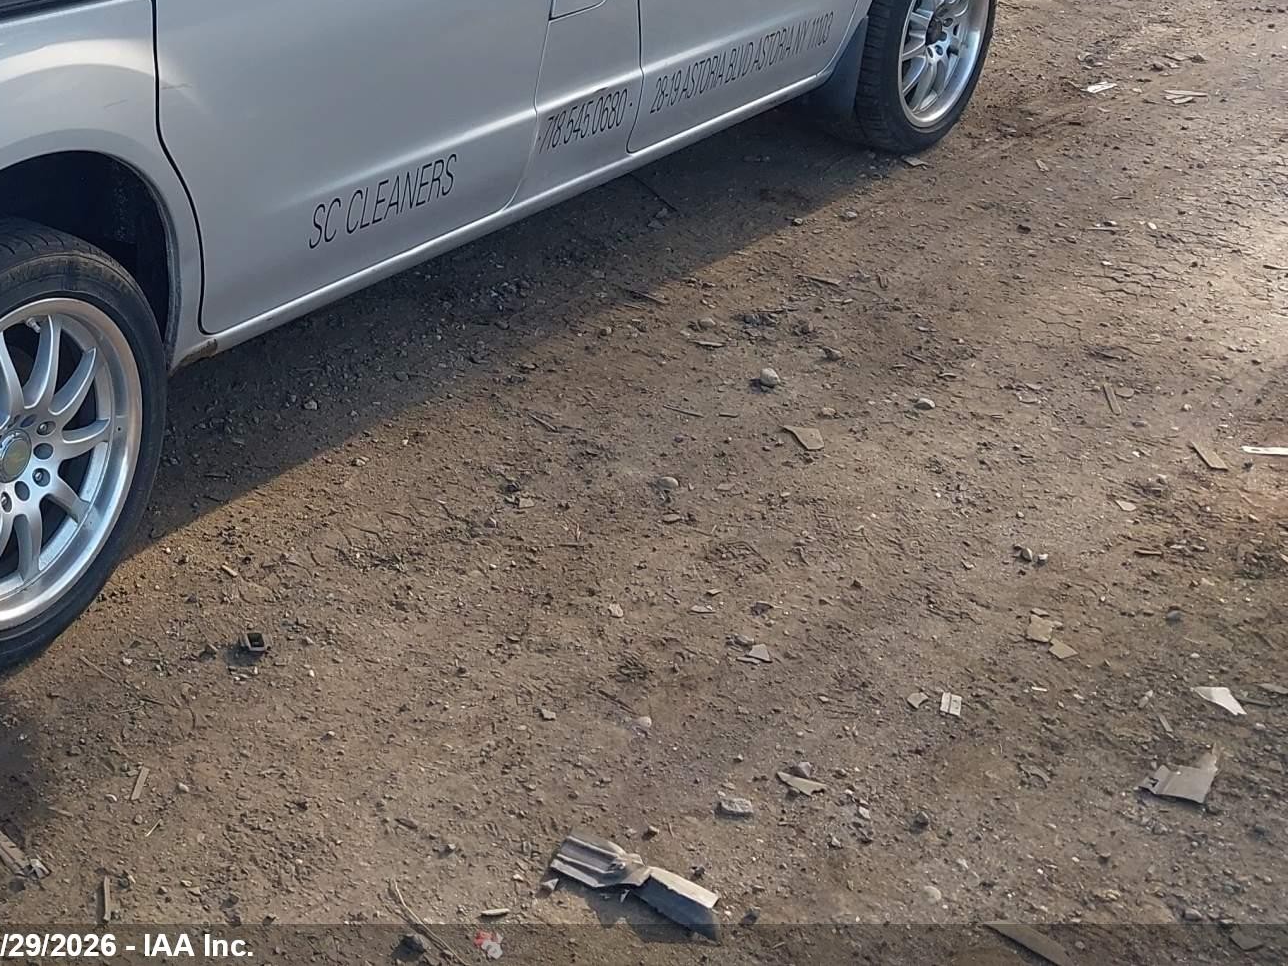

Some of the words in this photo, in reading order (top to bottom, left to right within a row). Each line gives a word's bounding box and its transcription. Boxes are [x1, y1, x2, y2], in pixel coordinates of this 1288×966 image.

[650, 69, 681, 114] 28-19
[678, 53, 726, 103] ASTORIA
[724, 42, 753, 83] BLVD
[750, 26, 794, 72] ASTORIA
[309, 198, 341, 249] SC
[346, 154, 457, 234] CLEANERS
